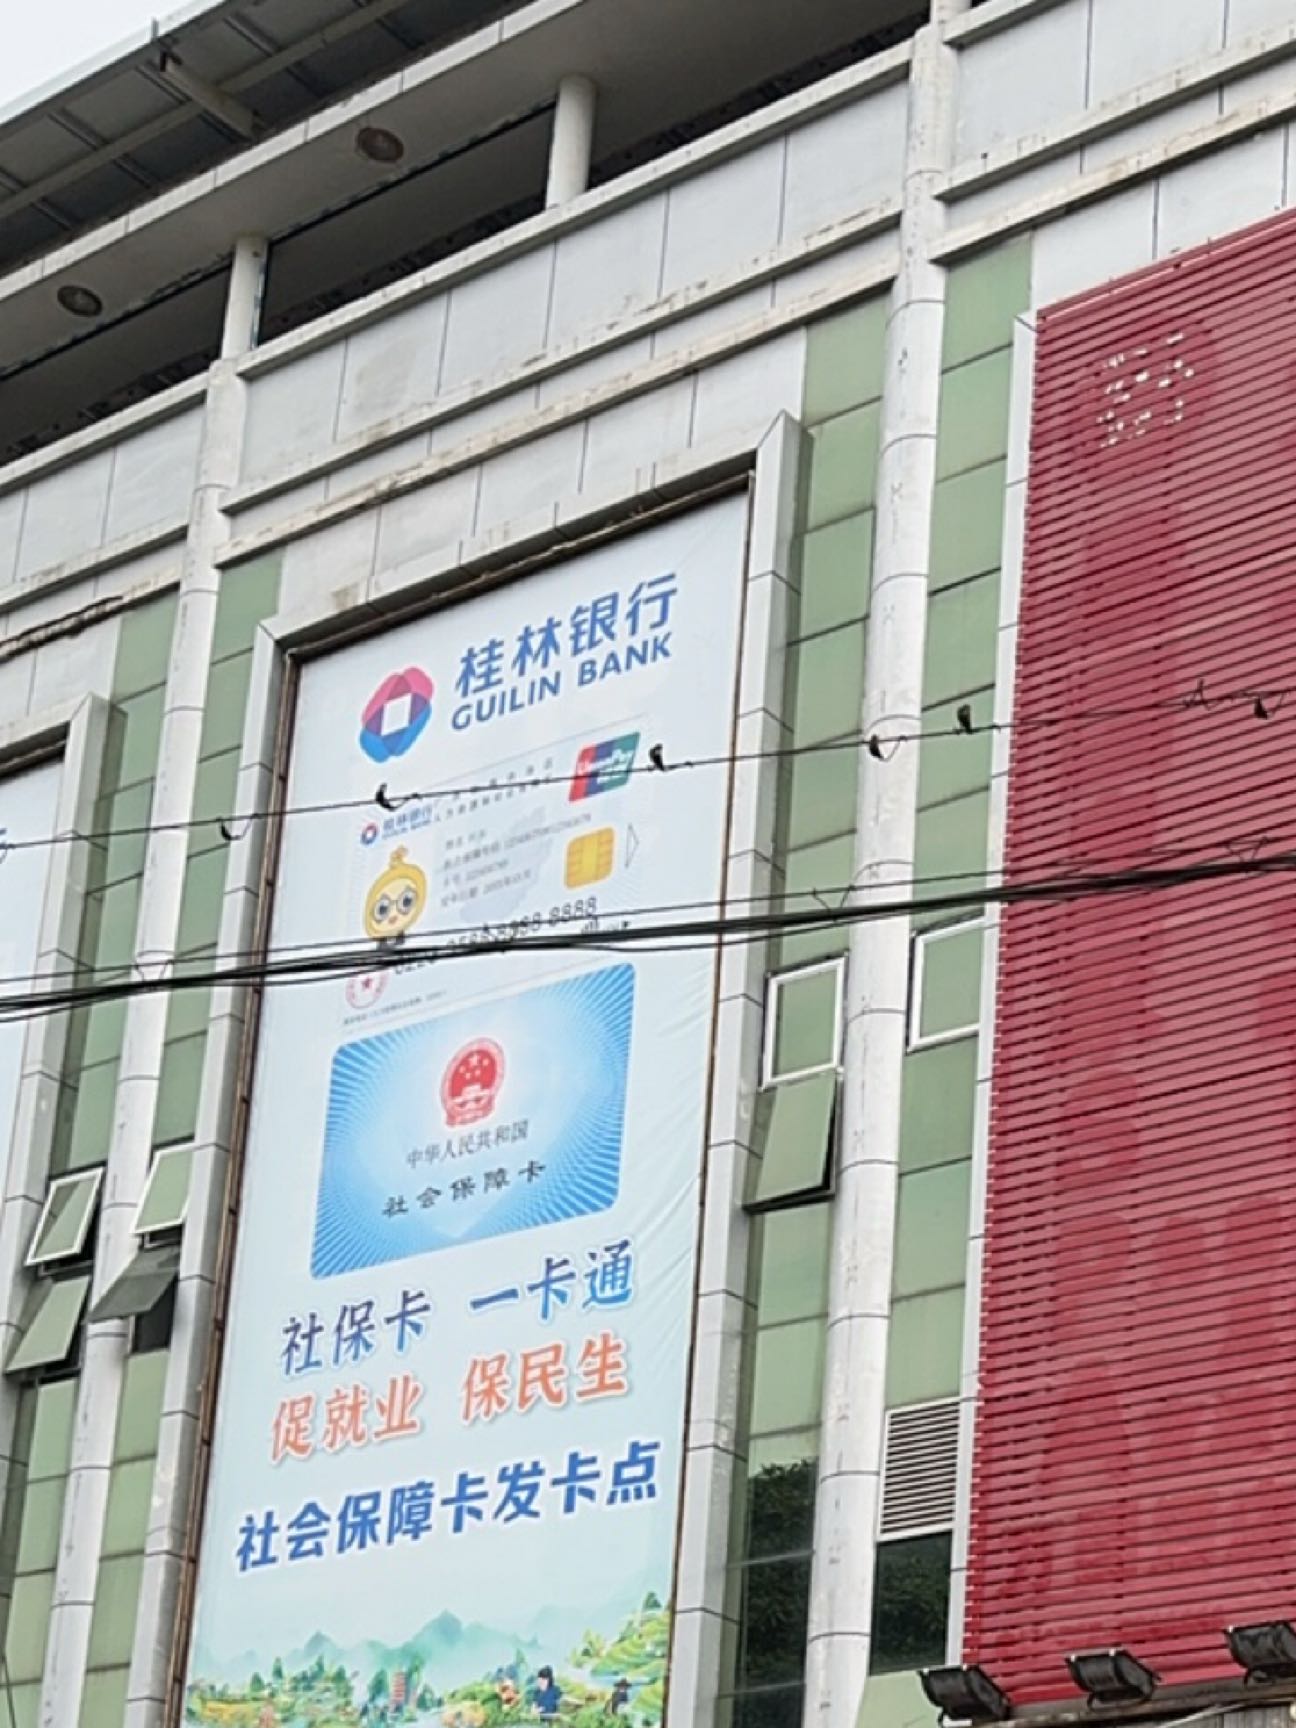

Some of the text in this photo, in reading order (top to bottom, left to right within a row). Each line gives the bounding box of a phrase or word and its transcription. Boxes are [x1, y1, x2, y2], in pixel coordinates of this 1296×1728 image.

[451, 632, 671, 731] GUILIN BANK
[455, 572, 679, 698] 桂林银行
[382, 1160, 546, 1218] 社会保障卡
[406, 1119, 529, 1170] 中华人民共和国
[282, 1239, 634, 1376] 社保卡 一卡通
[270, 1330, 629, 1463] 促就业 保民生
[235, 1440, 661, 1573] 社会保障卡发卡点
